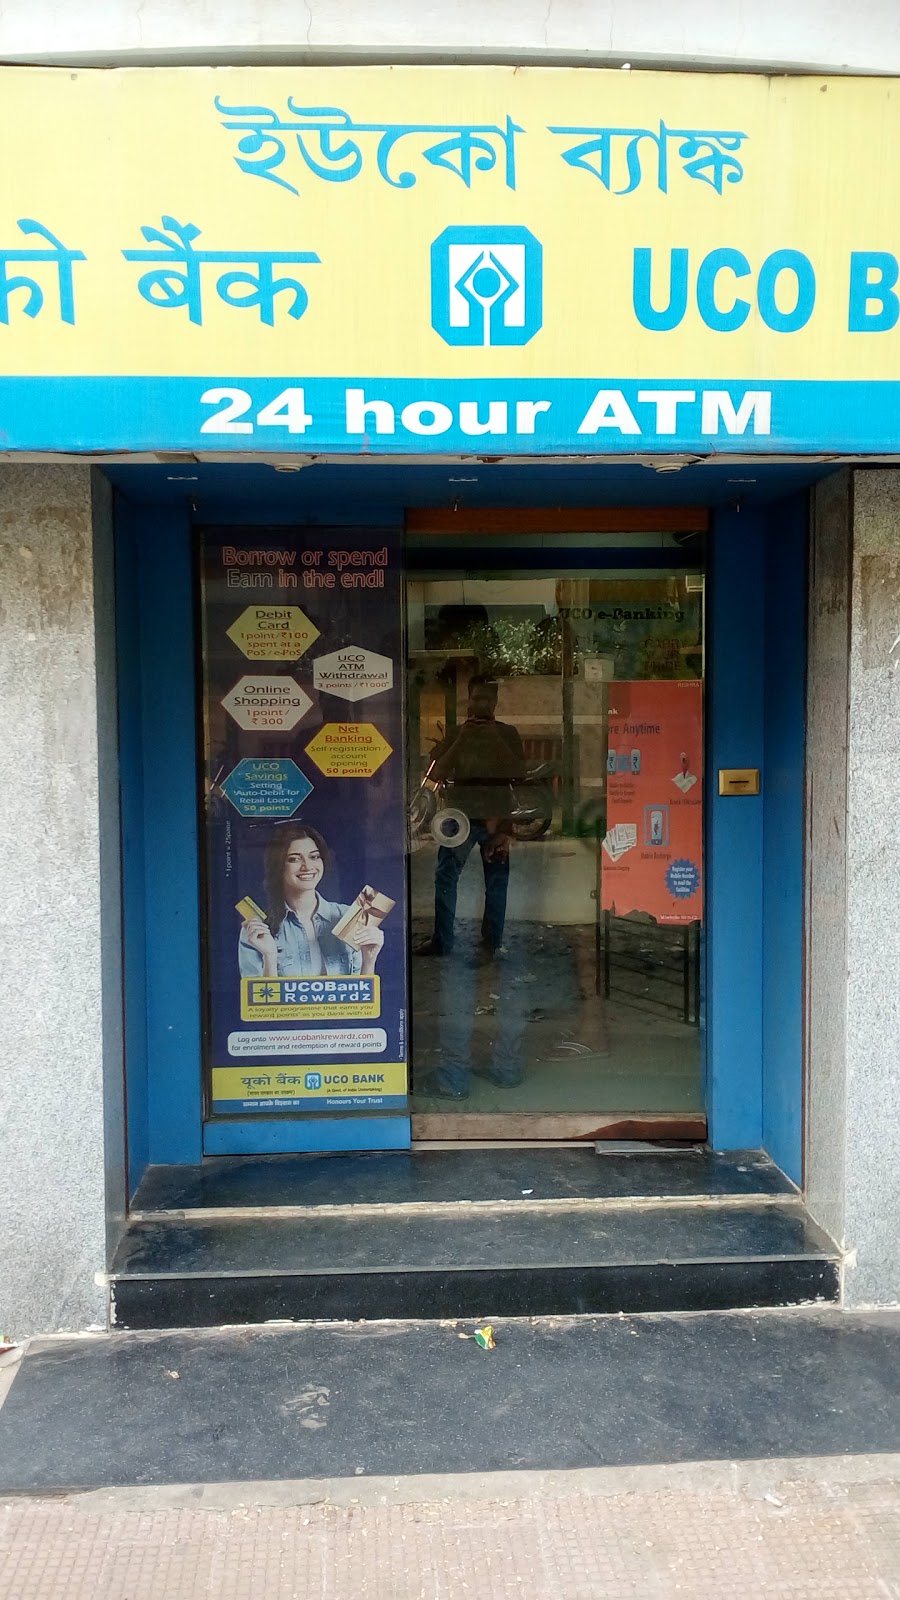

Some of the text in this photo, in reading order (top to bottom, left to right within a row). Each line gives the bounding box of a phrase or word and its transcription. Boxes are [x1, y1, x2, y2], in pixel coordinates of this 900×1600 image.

[214, 95, 749, 196] ইউকো ব্যাঙ্ক
[120, 215, 321, 327] बैंक
[632, 247, 816, 333] UCO
[200, 387, 773, 436] 24 hour ATM
[222, 546, 388, 571] Borrow or spend
[226, 569, 385, 588] Earn in the end!
[255, 610, 292, 618] Debit
[559, 607, 685, 622] UCO e-Banking
[257, 621, 290, 630] Card
[338, 654, 366, 662] UCO
[319, 672, 388, 680] Withdrawal
[243, 685, 291, 694] Online
[234, 696, 301, 706] Shopping
[338, 725, 360, 734] Net
[623, 722, 660, 737] Anytime
[325, 734, 373, 744] Banking
[252, 762, 280, 770] UCO
[330, 760, 368, 768] opening
[244, 772, 288, 781] Savings
[284, 980, 370, 992] UCOBank
[284, 992, 372, 1003] Rewardz
[237, 1036, 250, 1044] Log
[268, 1032, 374, 1042] www.ucobankrewardz.com
[362, 1041, 382, 1050] points
[240, 1072, 301, 1089] यूको बैंक
[324, 1074, 385, 1084] UCO BANK
